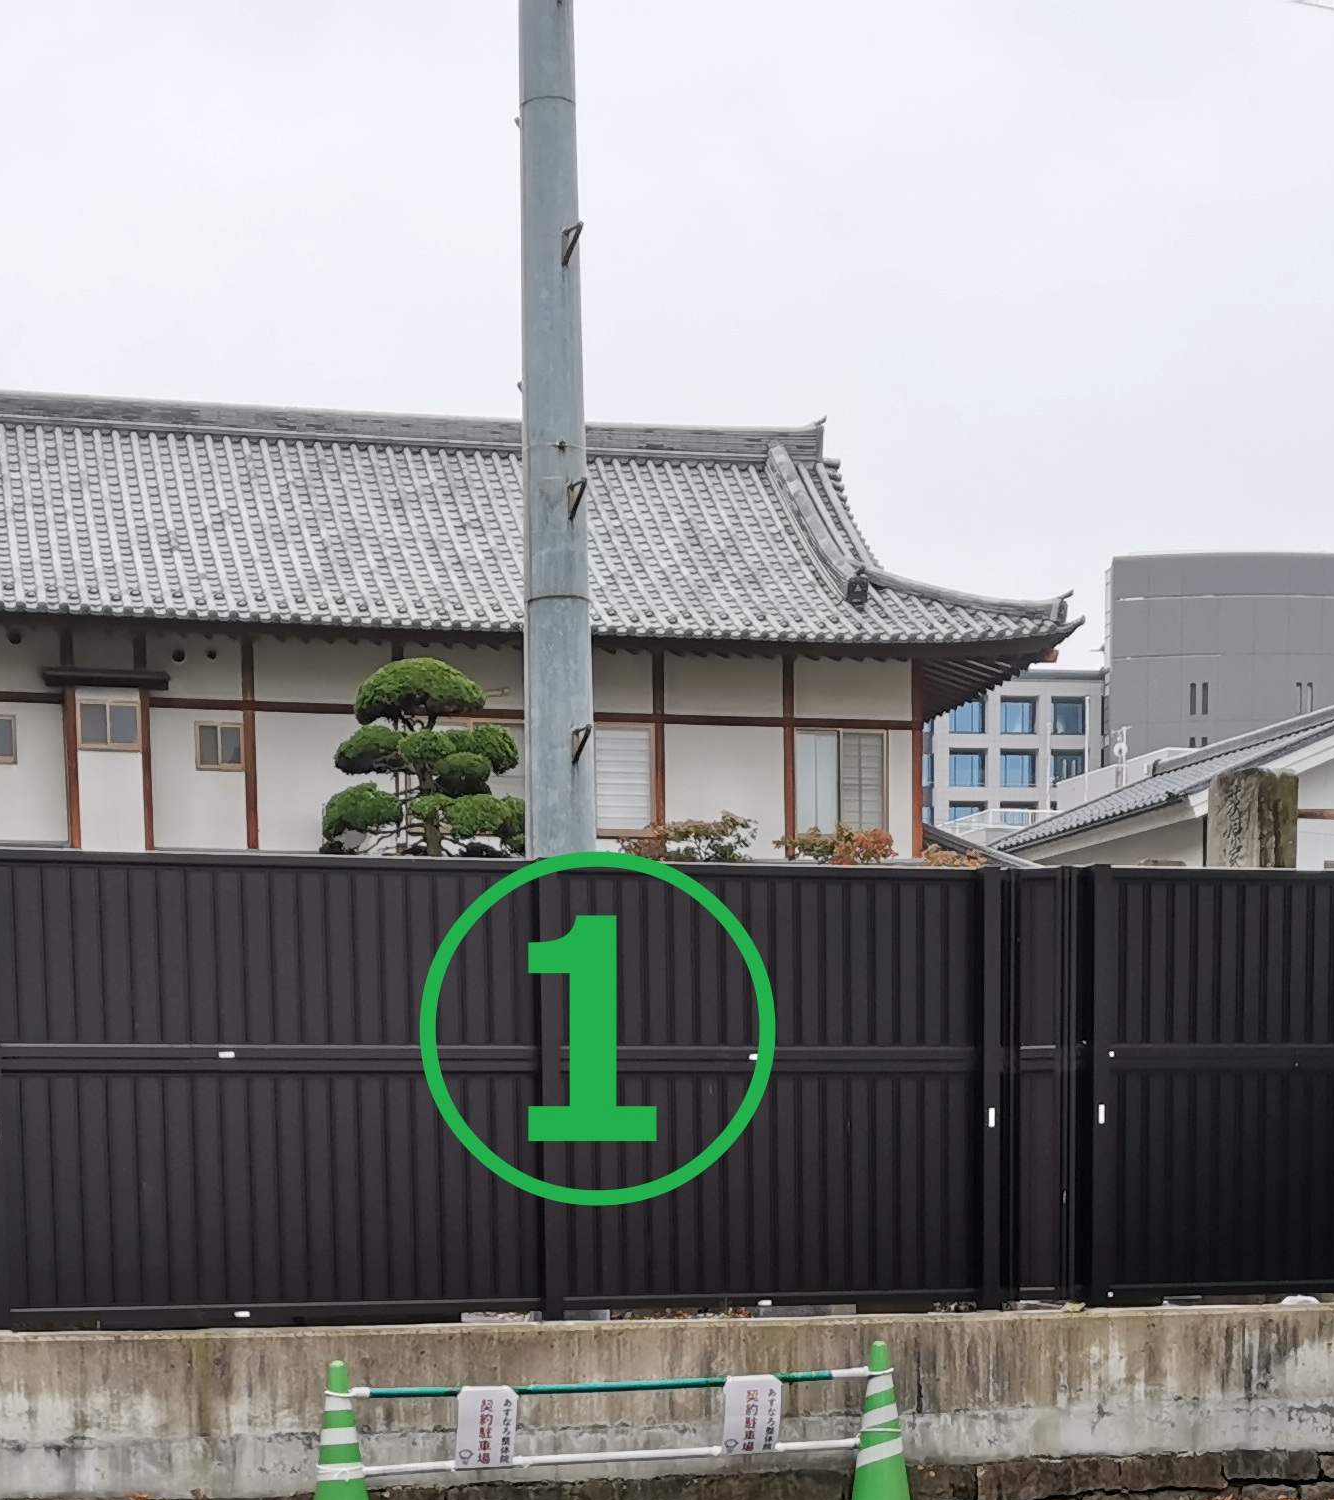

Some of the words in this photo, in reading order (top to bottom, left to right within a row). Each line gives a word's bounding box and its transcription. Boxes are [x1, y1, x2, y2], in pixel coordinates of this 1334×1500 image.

[477, 1398, 494, 1465] 契約駐車場
[741, 1388, 759, 1452] 契約駐車場
